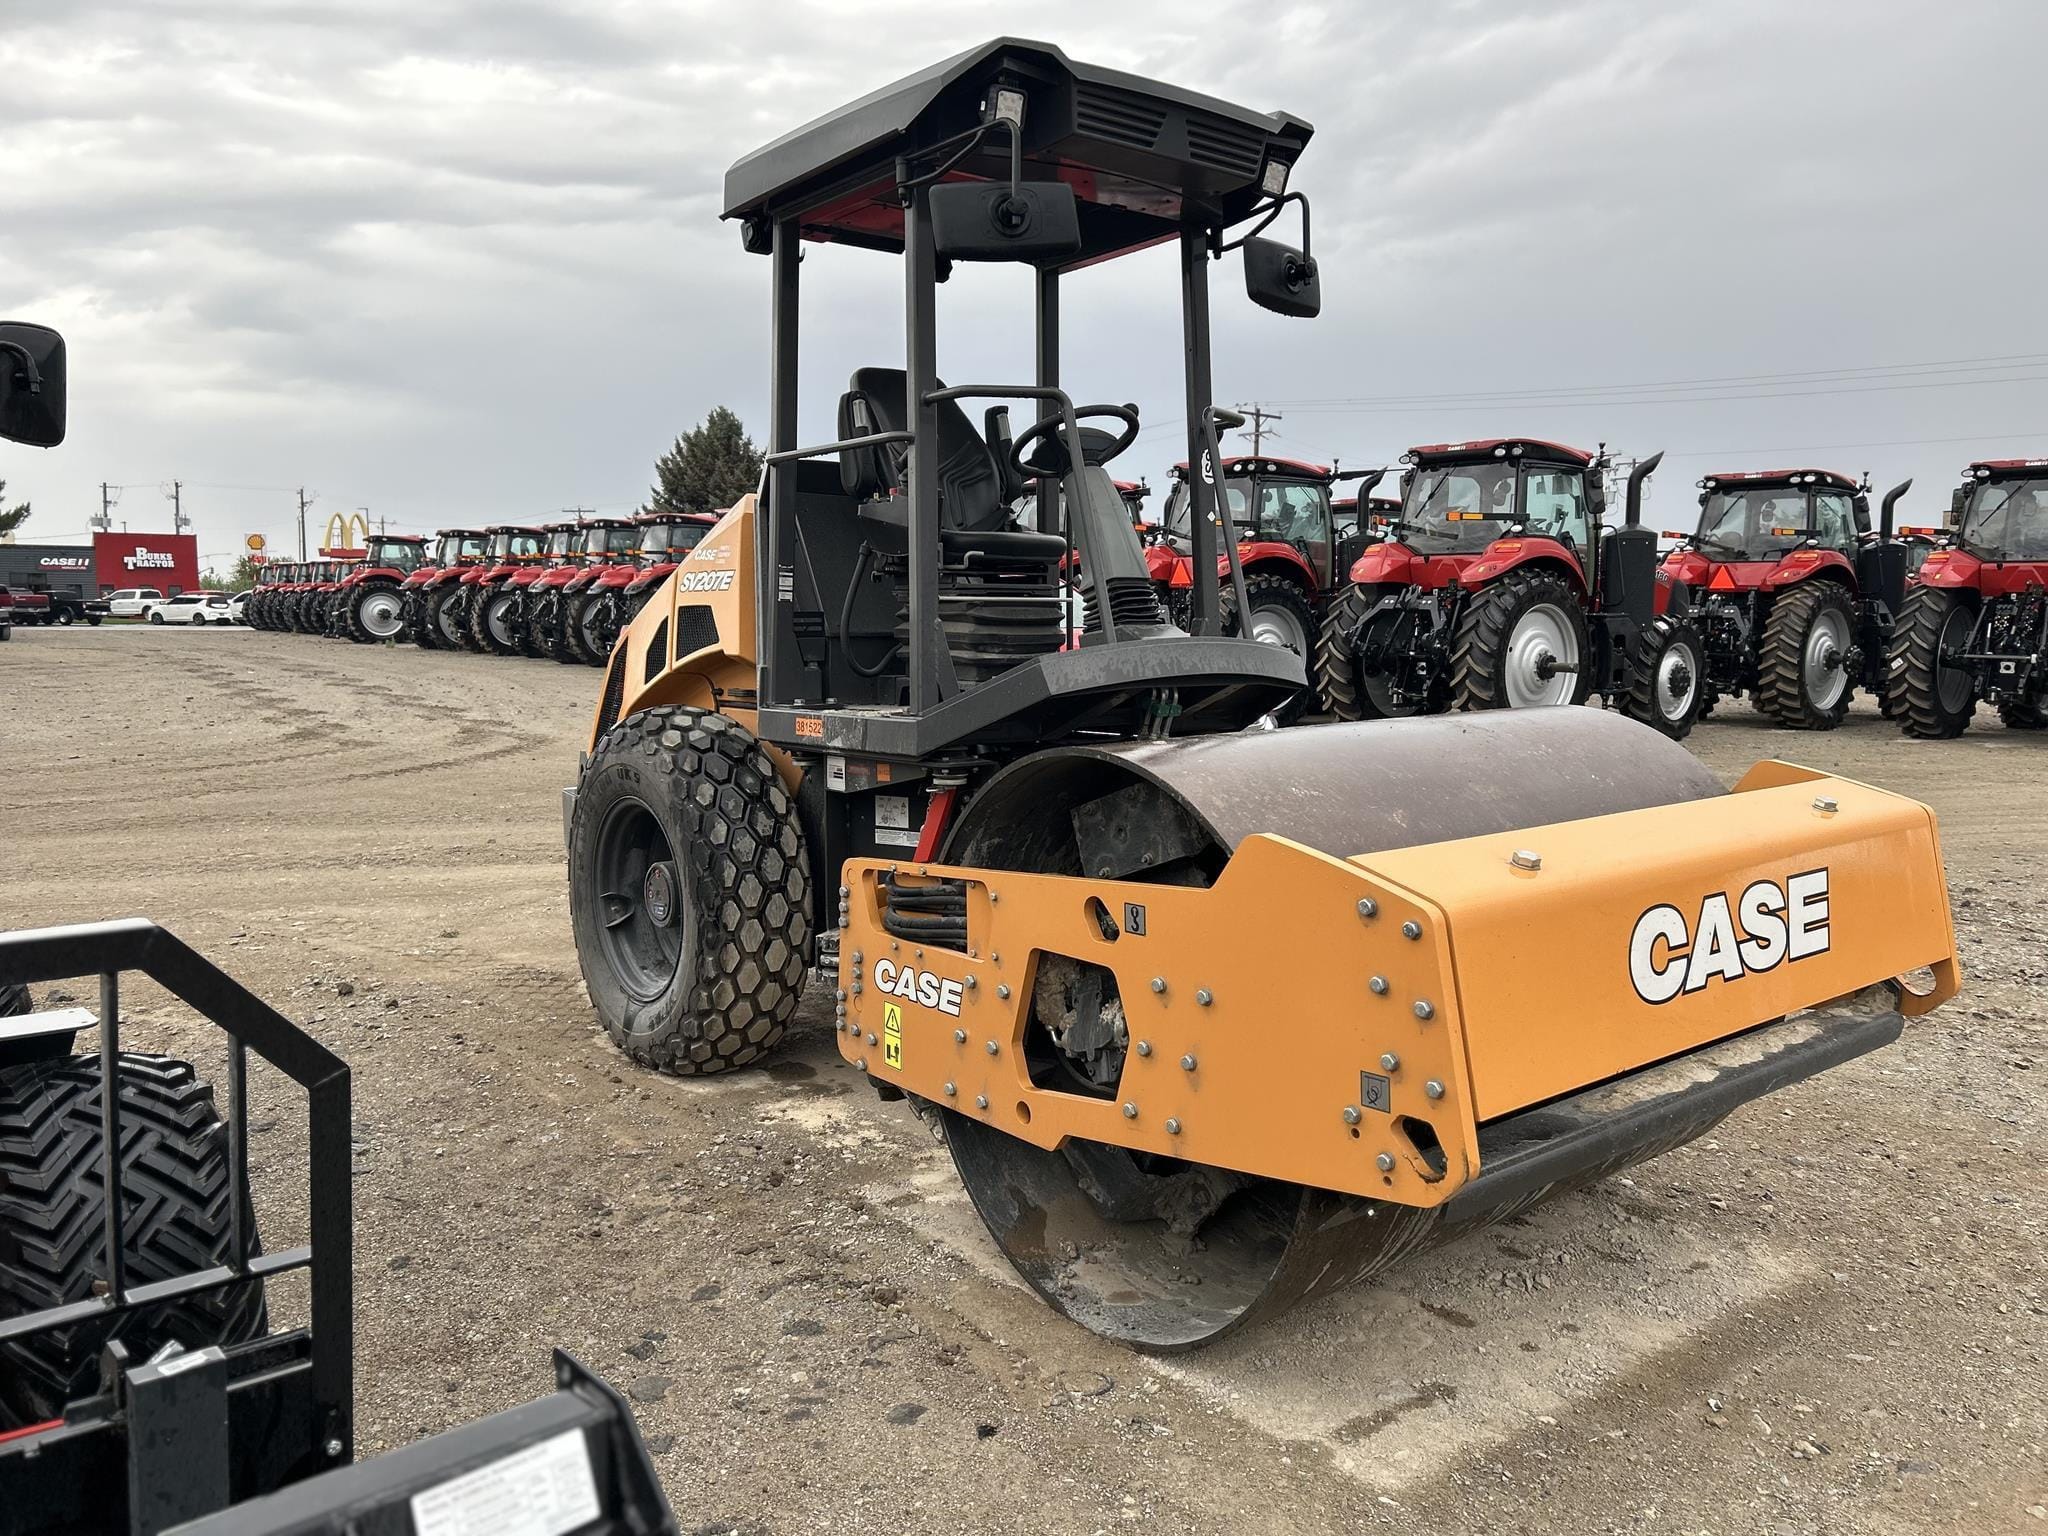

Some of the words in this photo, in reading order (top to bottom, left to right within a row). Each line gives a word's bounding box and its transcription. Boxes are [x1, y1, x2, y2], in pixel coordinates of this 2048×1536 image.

[135, 547, 172, 560] BURKS
[694, 549, 717, 560] CASE
[40, 557, 77, 566] CASE
[123, 556, 175, 570] TRACTOR
[680, 569, 736, 593] SV207E
[796, 720, 822, 734] 381522
[1628, 866, 1831, 1005] CASE
[873, 958, 964, 1018] CASE
